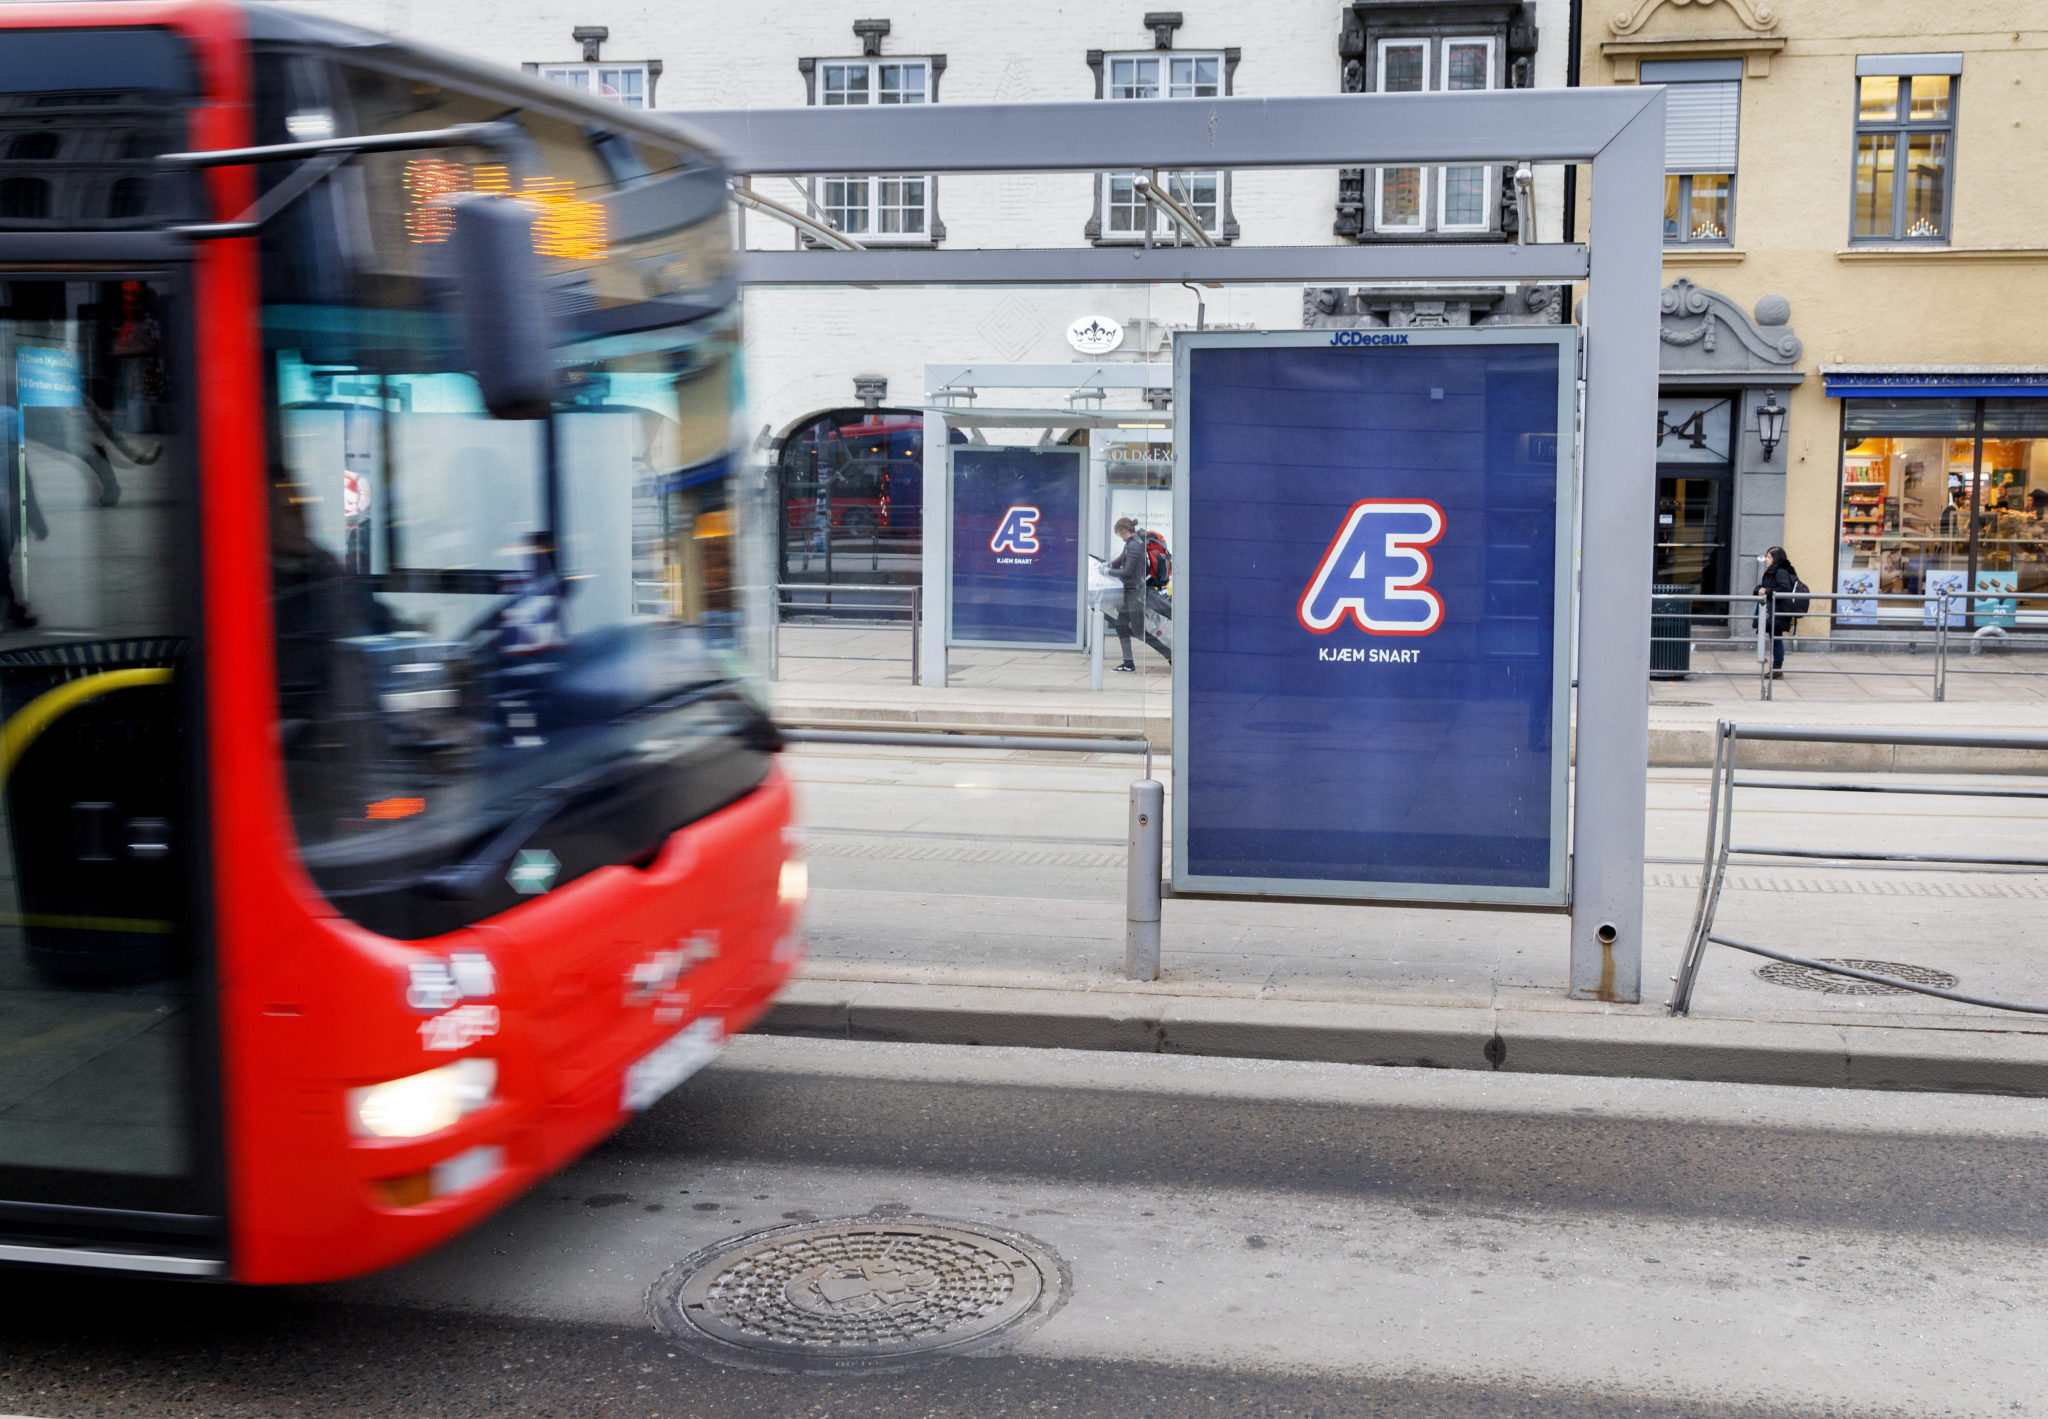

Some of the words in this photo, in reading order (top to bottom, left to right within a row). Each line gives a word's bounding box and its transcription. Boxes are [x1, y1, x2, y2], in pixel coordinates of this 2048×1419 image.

[1330, 331, 1408, 345] JCDecaux
[990, 505, 1041, 554] Æ
[1296, 498, 1448, 636] Æ
[1318, 648, 1365, 662] KJÆM
[1368, 649, 1421, 663] SNART
